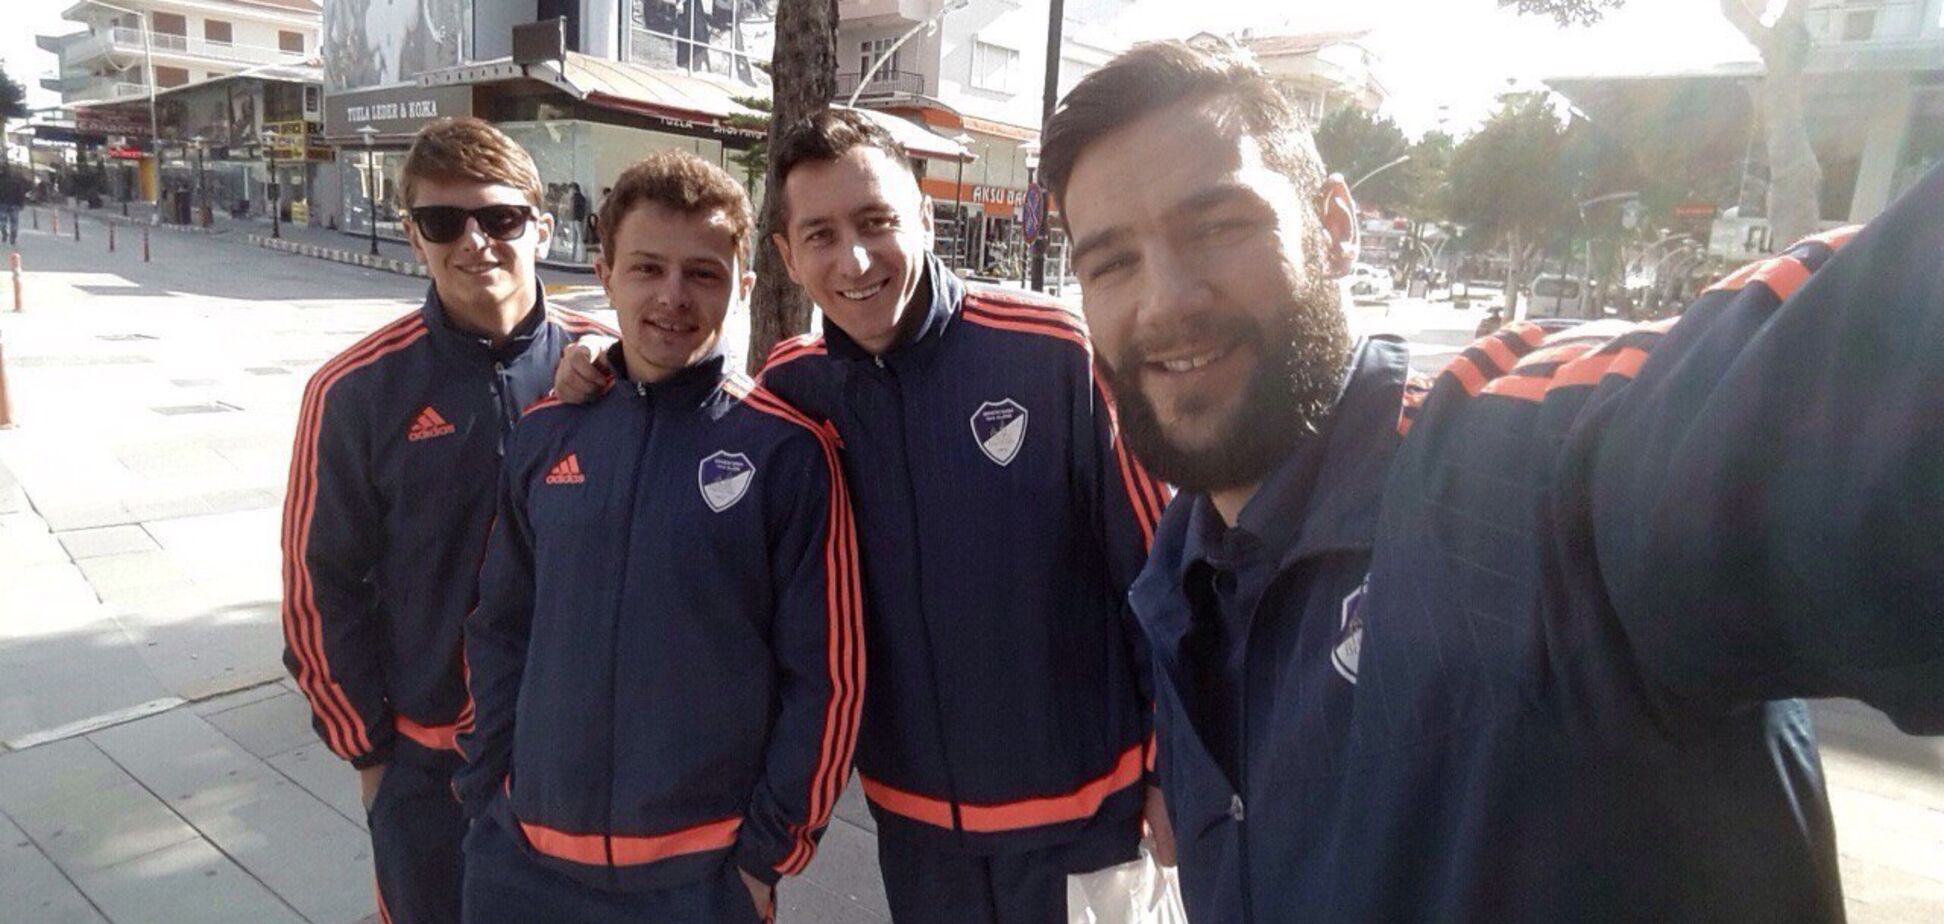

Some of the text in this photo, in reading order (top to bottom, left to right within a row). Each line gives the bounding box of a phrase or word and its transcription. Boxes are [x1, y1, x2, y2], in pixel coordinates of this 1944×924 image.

[371, 103, 398, 120] LEDER
[973, 186, 1005, 204] AKSU
[408, 423, 455, 442] adidas
[546, 473, 585, 484] adidas
